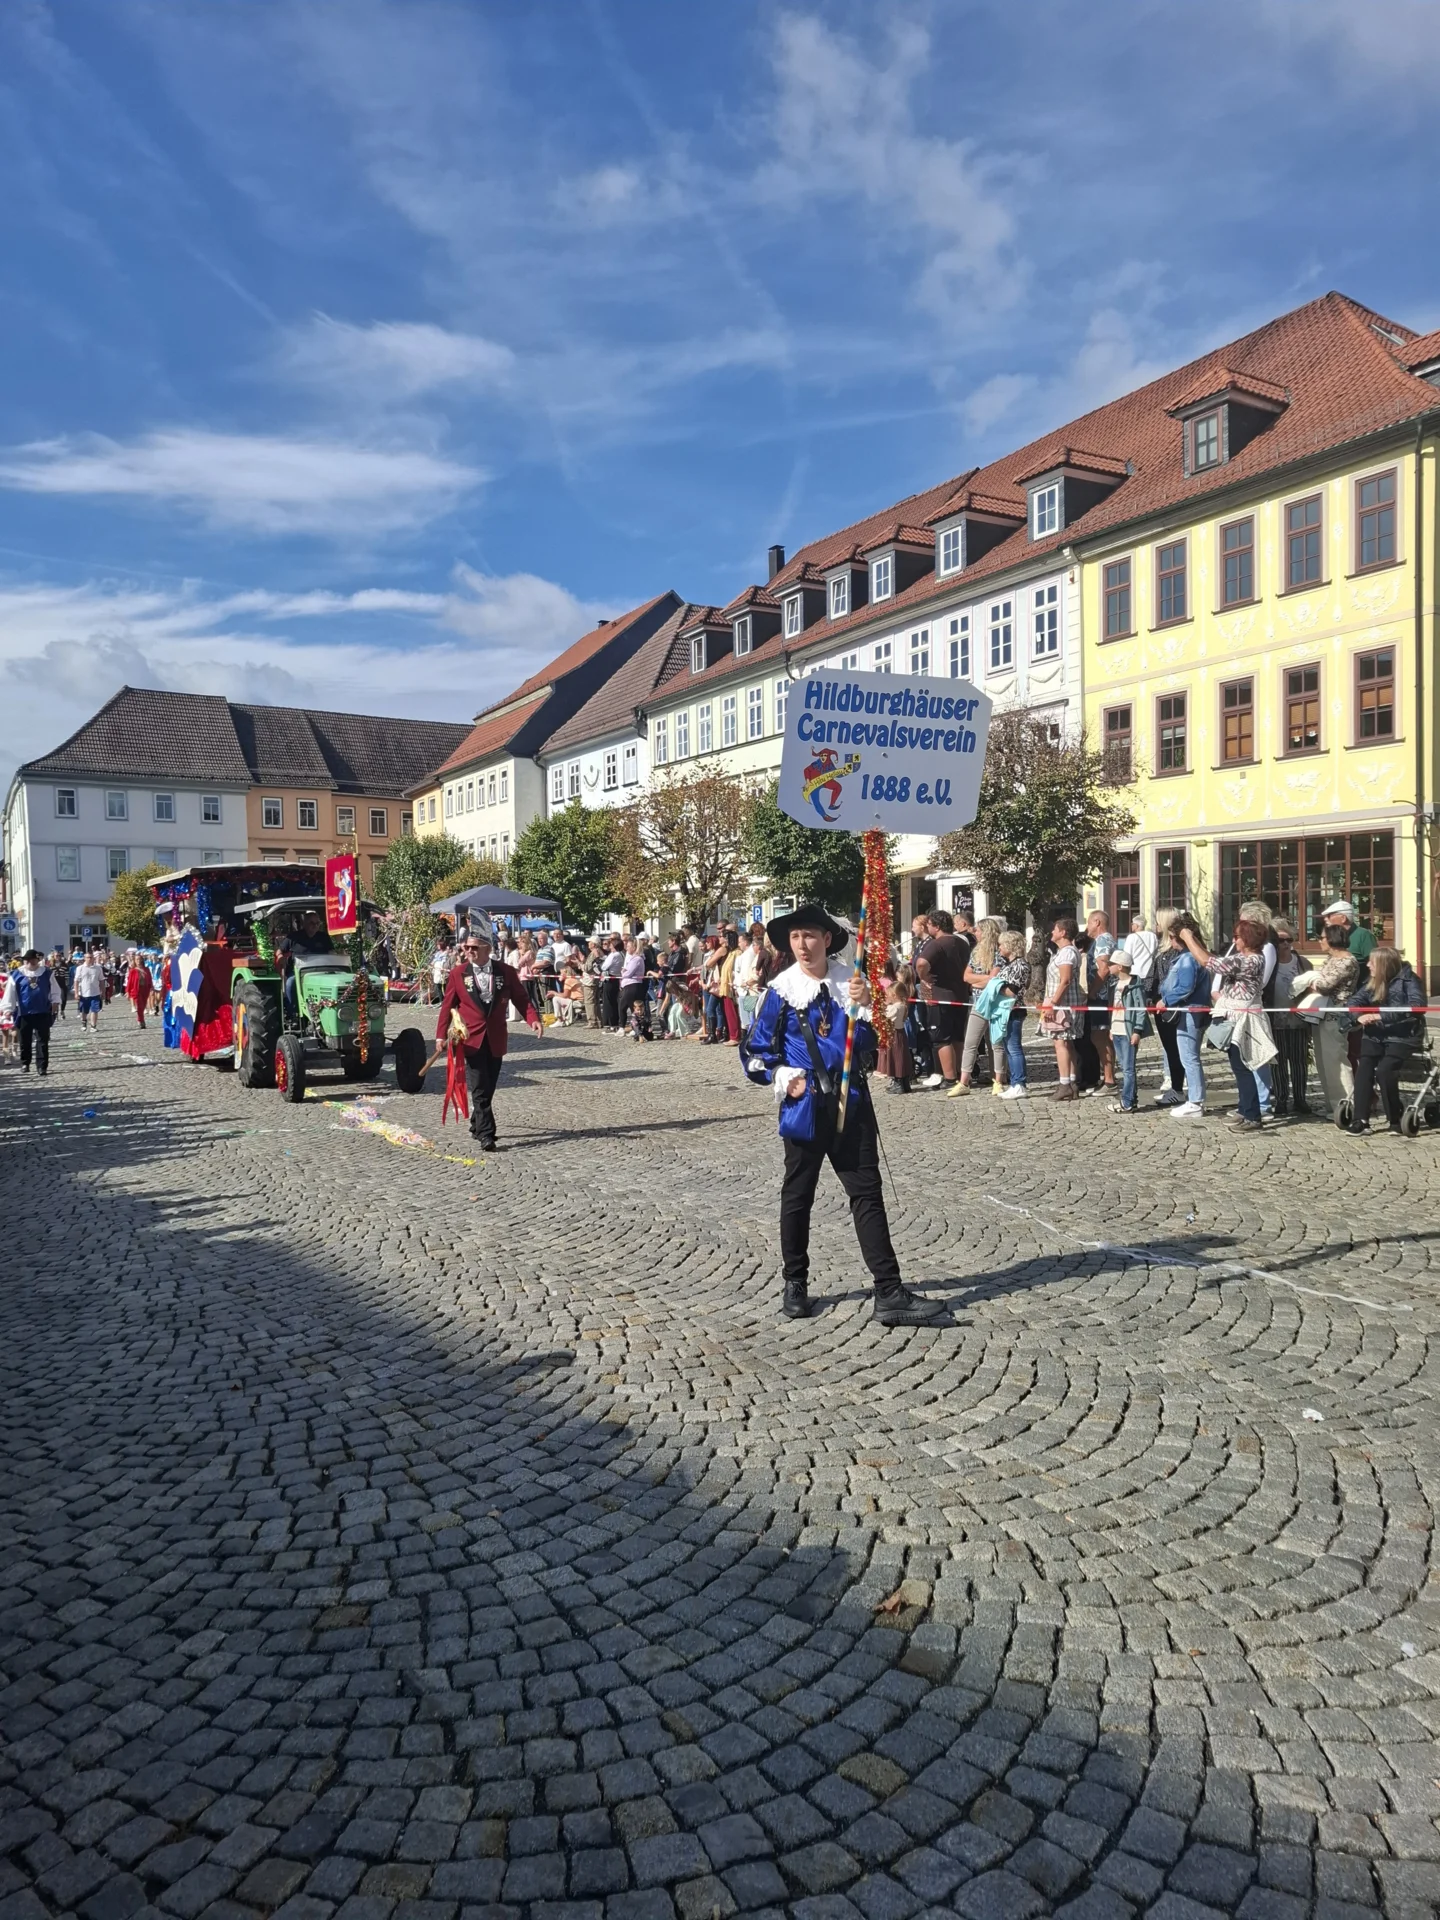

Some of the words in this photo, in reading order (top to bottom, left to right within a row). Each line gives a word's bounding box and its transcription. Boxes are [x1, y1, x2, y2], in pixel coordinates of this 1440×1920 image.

[804, 680, 979, 721] Hildburghäuser
[797, 712, 977, 753] Carnevalsverein
[861, 774, 911, 802] 1888
[916, 779, 953, 806] e.V.
[754, 907, 761, 920] P
[84, 928, 91, 936] P
